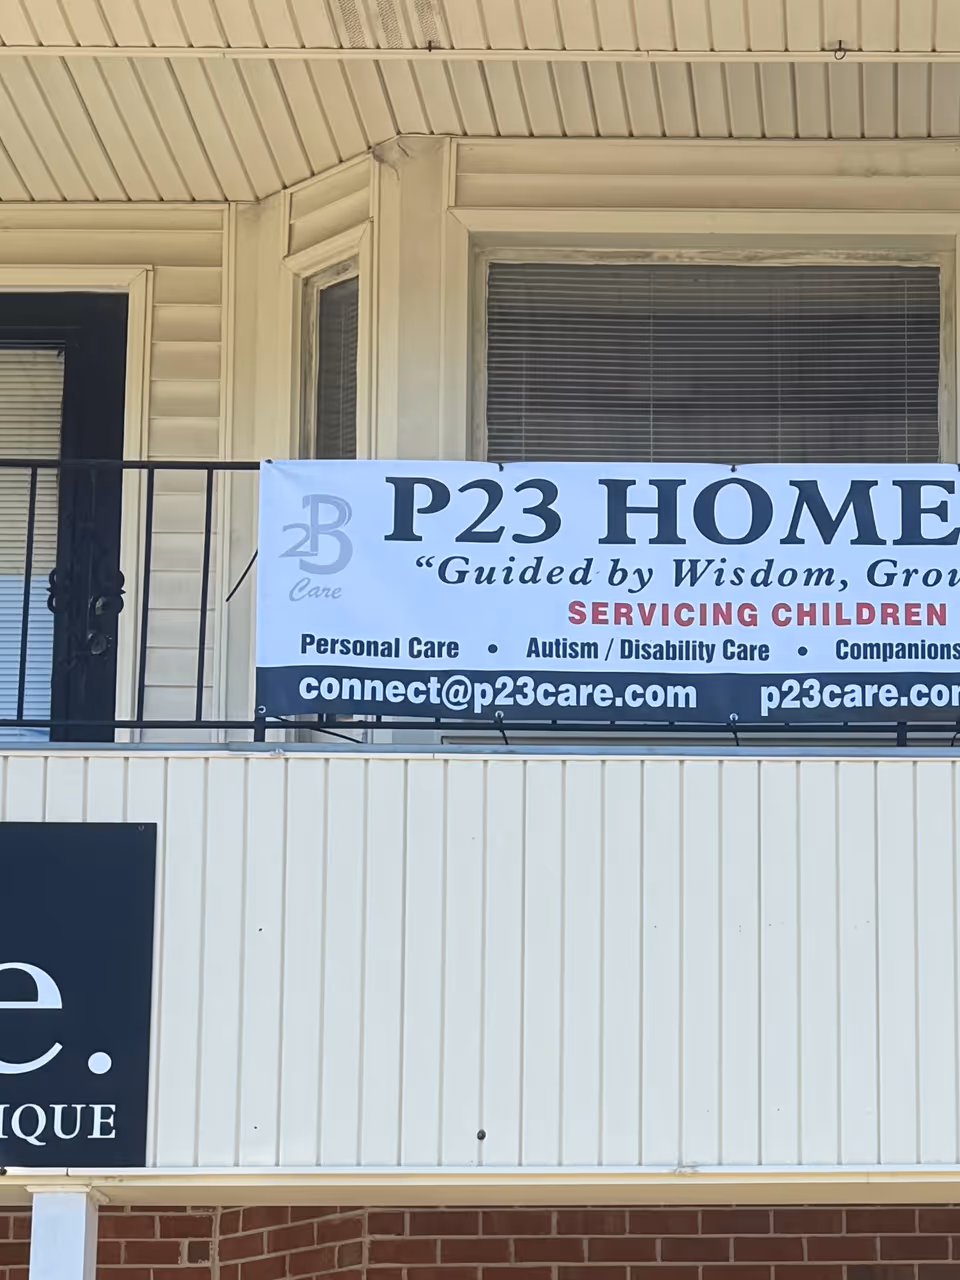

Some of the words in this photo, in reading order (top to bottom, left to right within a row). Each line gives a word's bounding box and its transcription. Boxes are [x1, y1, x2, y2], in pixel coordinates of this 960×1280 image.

[384, 477, 561, 543] P23
[599, 478, 960, 545] HOME
[289, 577, 342, 602] Care
[416, 556, 593, 586] “Guided
[608, 559, 653, 593] by
[673, 558, 847, 593] Wisdom,
[568, 601, 757, 627] SERVICING
[772, 602, 946, 627] CHILDREN
[300, 634, 400, 658] Personal
[409, 637, 459, 659] Care
[527, 638, 598, 660] Autism
[621, 639, 715, 664] Disability
[723, 639, 770, 661] Care
[298, 675, 698, 711] connect@p23care.com
